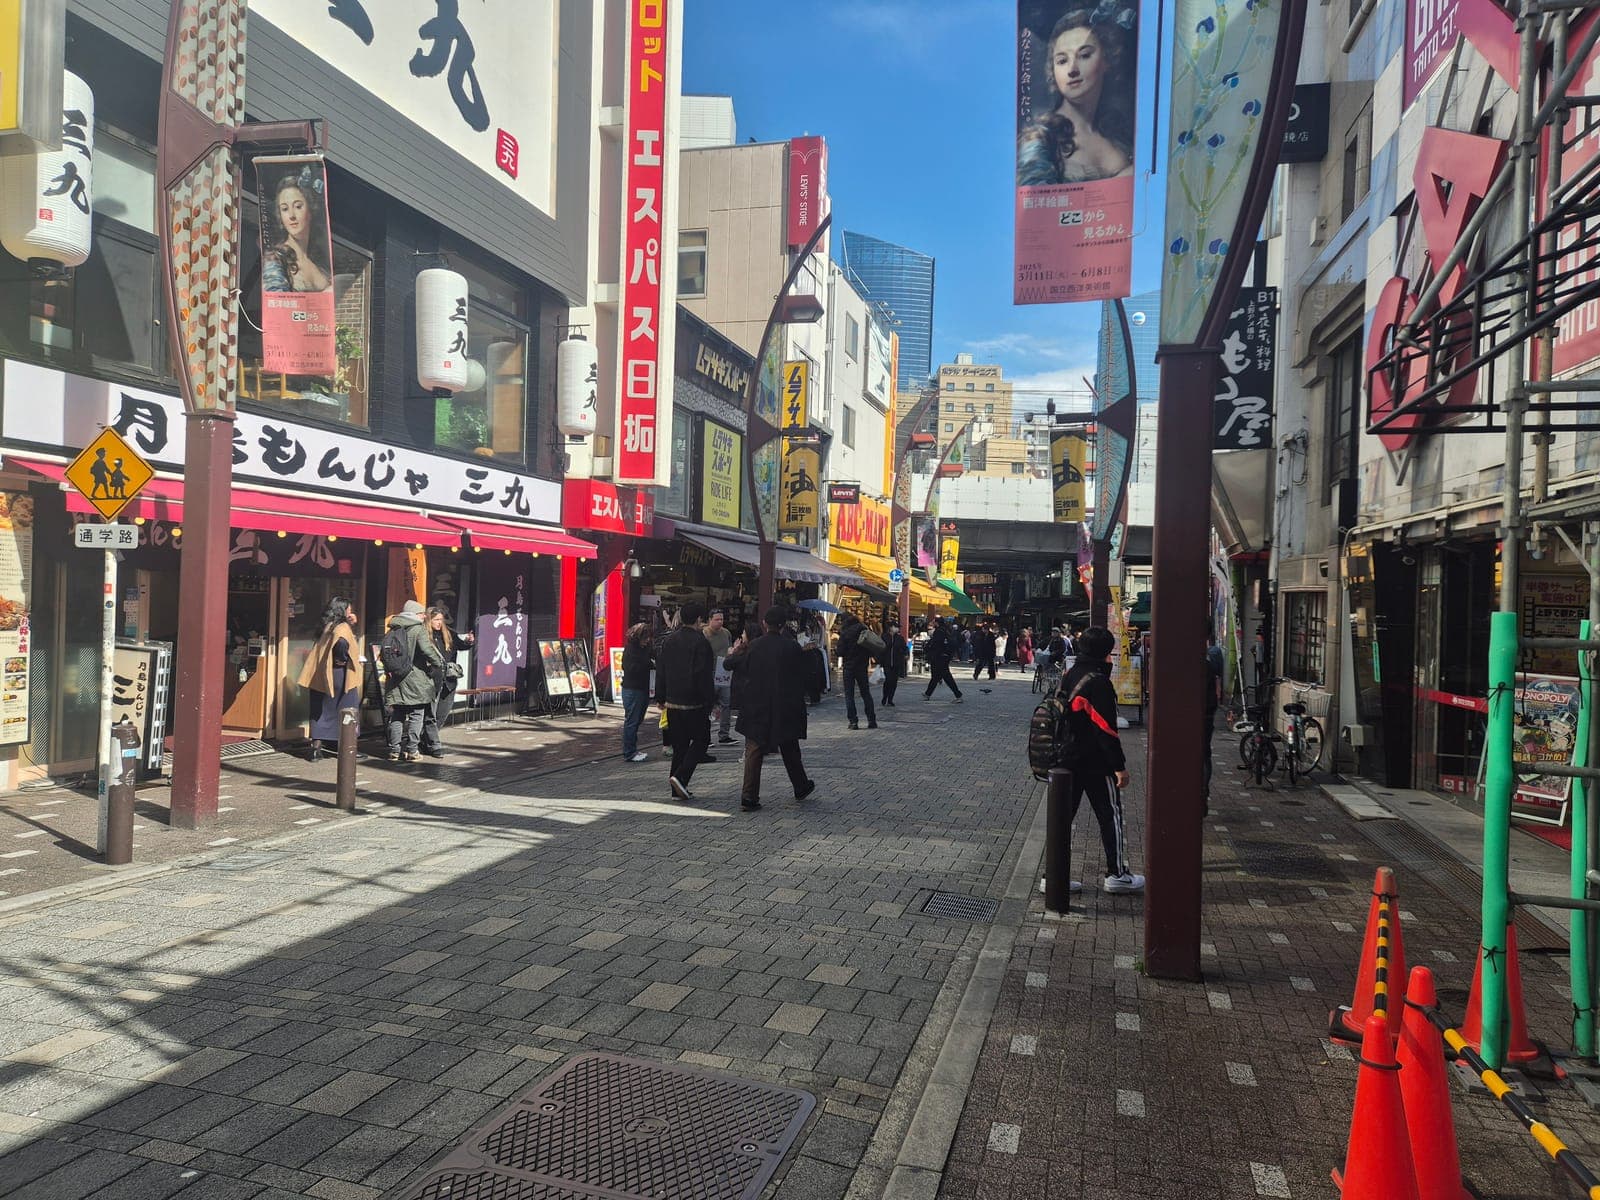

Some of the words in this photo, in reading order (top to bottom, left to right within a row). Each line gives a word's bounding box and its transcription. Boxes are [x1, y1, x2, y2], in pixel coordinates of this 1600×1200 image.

[1413, 30, 1440, 82] TAITO
[1441, 2, 1459, 46] ST
[328, 0, 491, 131] 九
[1021, 27, 1031, 122] あなたに会いたい。
[799, 202, 807, 226] STORE
[1059, 210, 1105, 225] どこから
[1257, 291, 1275, 303] B1
[1554, 299, 1598, 343] AITO
[695, 343, 751, 398] ムラサキスポーツ
[712, 428, 733, 453] ムラサキ
[112, 391, 430, 495] 月もんじゃ
[460, 468, 531, 516] 三九
[711, 450, 733, 476] スポーツ
[711, 480, 722, 499] RIDE
[722, 484, 732, 502] LIFE
[79, 529, 133, 544] 通学路
[1514, 689, 1569, 704] MONOPOLY
